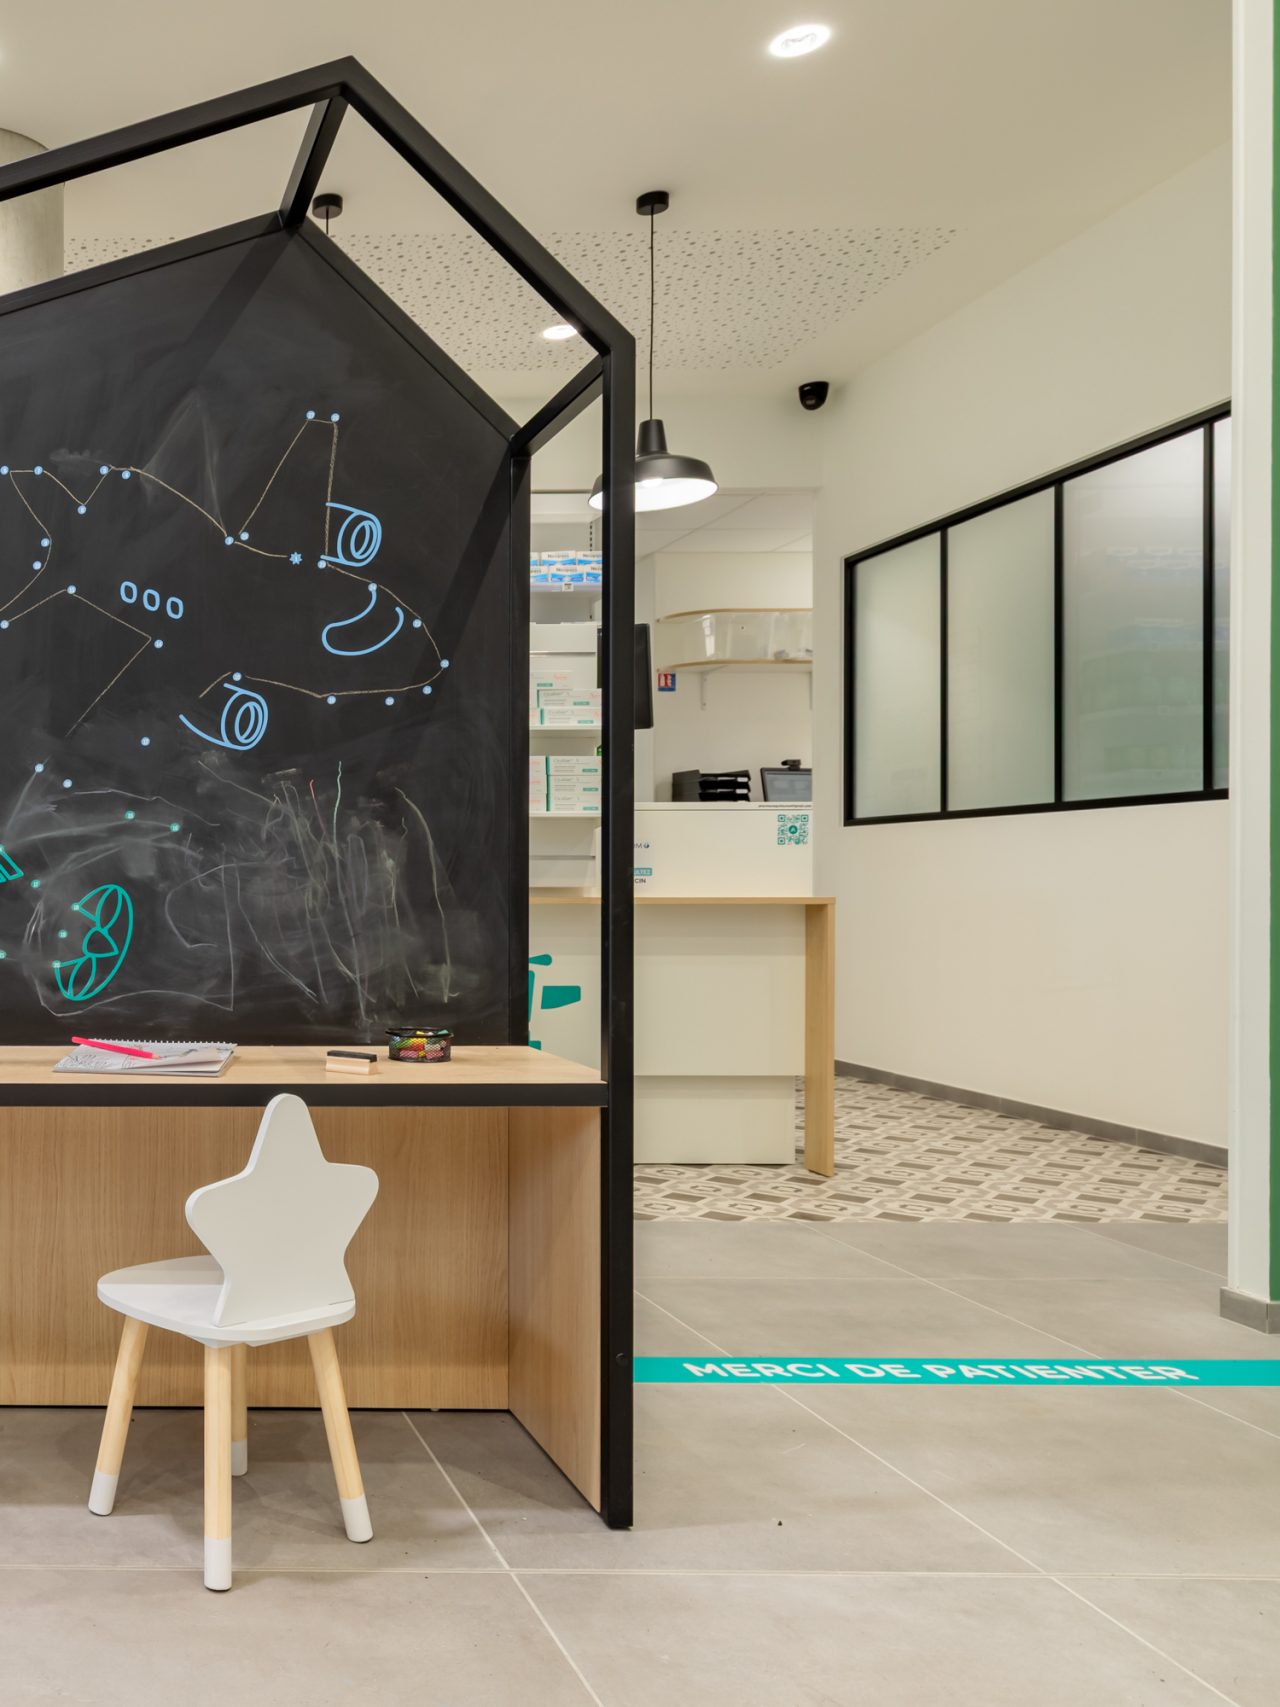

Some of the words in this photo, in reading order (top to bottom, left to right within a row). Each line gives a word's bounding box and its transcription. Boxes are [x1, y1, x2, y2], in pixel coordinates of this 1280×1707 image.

[682, 1362, 841, 1378] MERCI
[843, 1363, 922, 1378] DE
[921, 1364, 1200, 1380] PATIENTER
